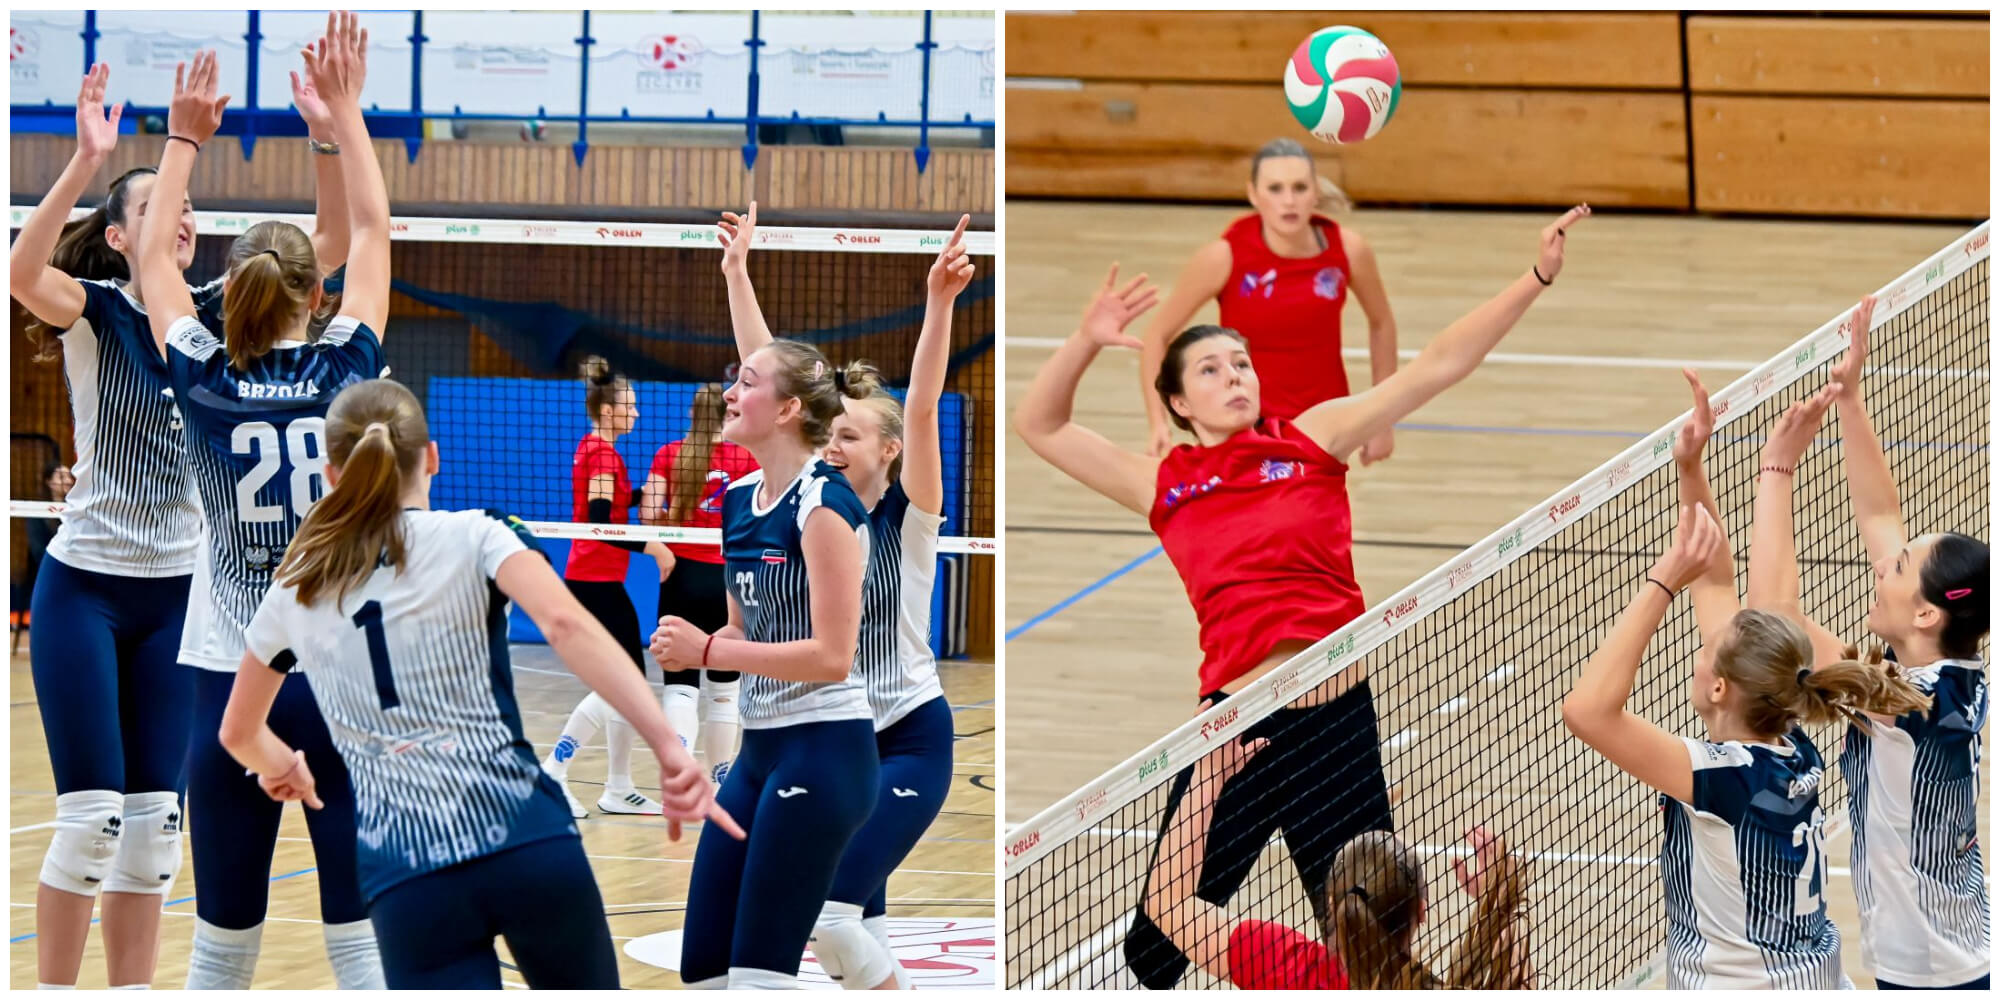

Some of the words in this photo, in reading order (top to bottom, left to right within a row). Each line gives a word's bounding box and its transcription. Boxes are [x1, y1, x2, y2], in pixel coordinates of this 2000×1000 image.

[612, 229, 643, 239] ORLEN
[680, 229, 703, 241] plus
[850, 235, 881, 244] ORLEN
[919, 235, 943, 247] plus
[1795, 351, 1809, 369] plus
[237, 378, 321, 398] BRZOZA
[1653, 442, 1668, 460] plus
[230, 416, 332, 523] 28
[1559, 493, 1581, 515] ORLEN
[735, 571, 760, 607] 22
[1394, 596, 1418, 619] ORLEN
[352, 599, 402, 712] 1
[1327, 641, 1345, 666] plus
[1213, 706, 1239, 732] ORLEN
[1138, 758, 1158, 783] plus
[1012, 829, 1041, 857] ORLEN
